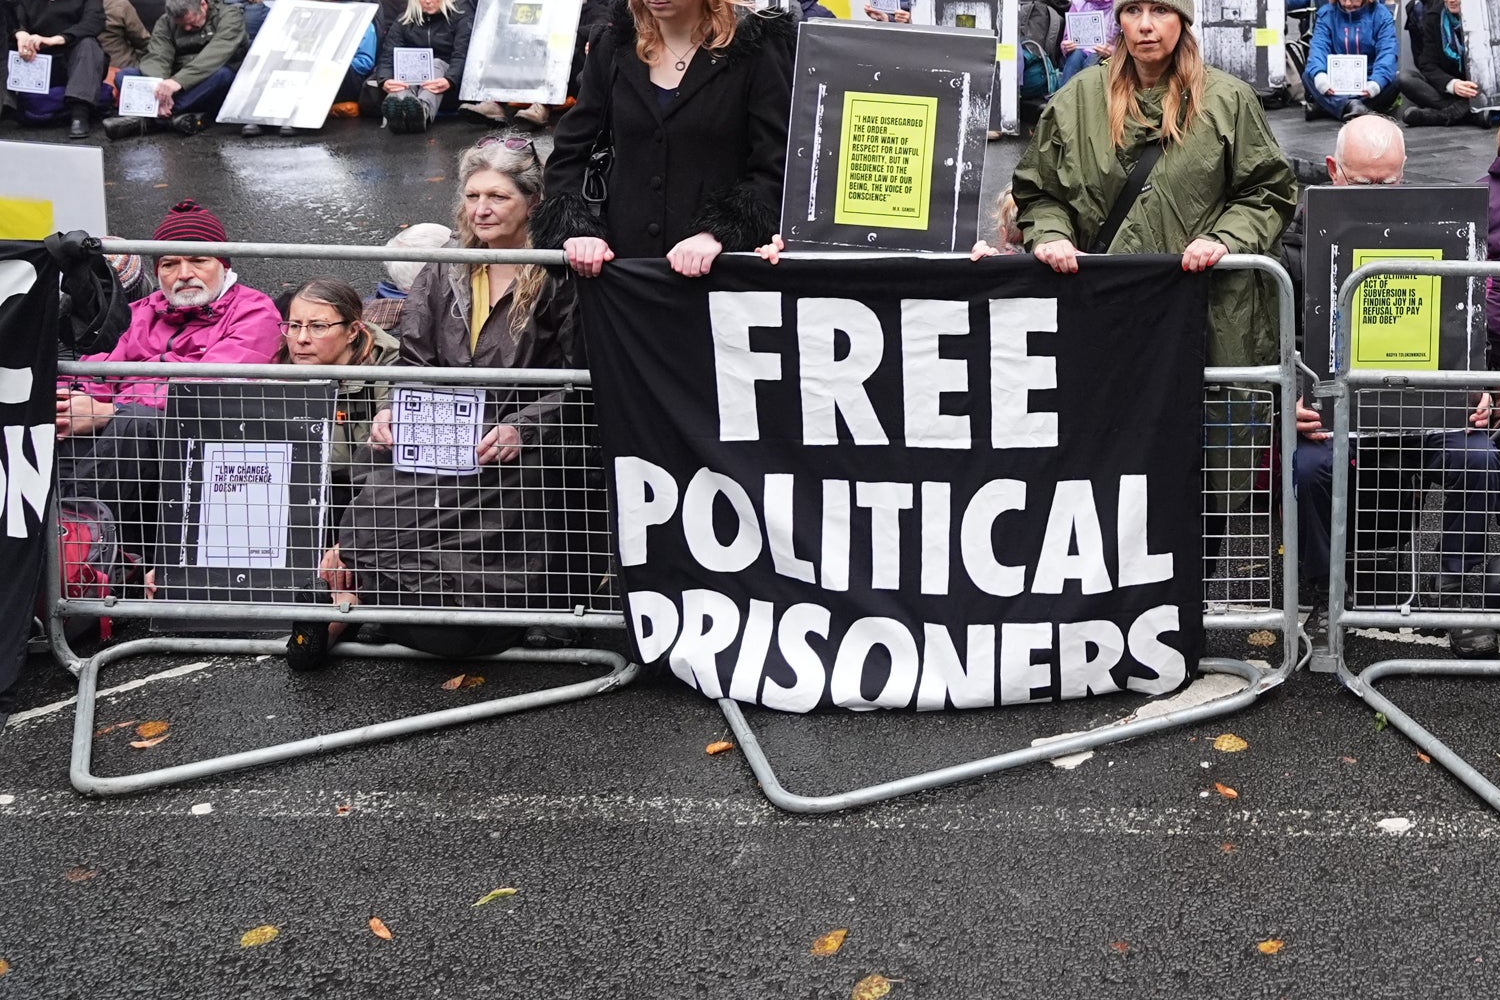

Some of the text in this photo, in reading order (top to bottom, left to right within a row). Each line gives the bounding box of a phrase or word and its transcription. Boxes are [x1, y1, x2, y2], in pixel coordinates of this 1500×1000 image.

[862, 116, 878, 125] HAVE
[880, 117, 923, 128] DISREGARDED
[854, 124, 865, 133] THE
[867, 126, 888, 135] ORDER
[853, 134, 866, 142] NOT
[880, 136, 899, 144] WANT
[900, 137, 909, 145] OF
[852, 144, 919, 156] RESPECT FOR LAWFUL
[889, 156, 901, 164] BUT
[902, 156, 909, 165] IN
[850, 163, 907, 174] OBEDIENCE TO THE
[850, 173, 872, 182] HIGHER
[874, 174, 889, 183] LAW
[900, 176, 912, 184] OUR
[872, 184, 882, 192] THE
[885, 185, 903, 193] VOICE
[904, 186, 913, 194] OF
[1364, 280, 1388, 289] ACT OF
[1364, 289, 1416, 298] SUBVERSION IS
[1364, 298, 1423, 306] FINDING JOY IN A
[1363, 307, 1420, 315] REFUSAL TO PAY
[1362, 316, 1401, 324] AND OBEY"
[709, 291, 1058, 449] FREE
[230, 475, 272, 483] CONSCIENCE
[615, 456, 1174, 597] POLITICAL
